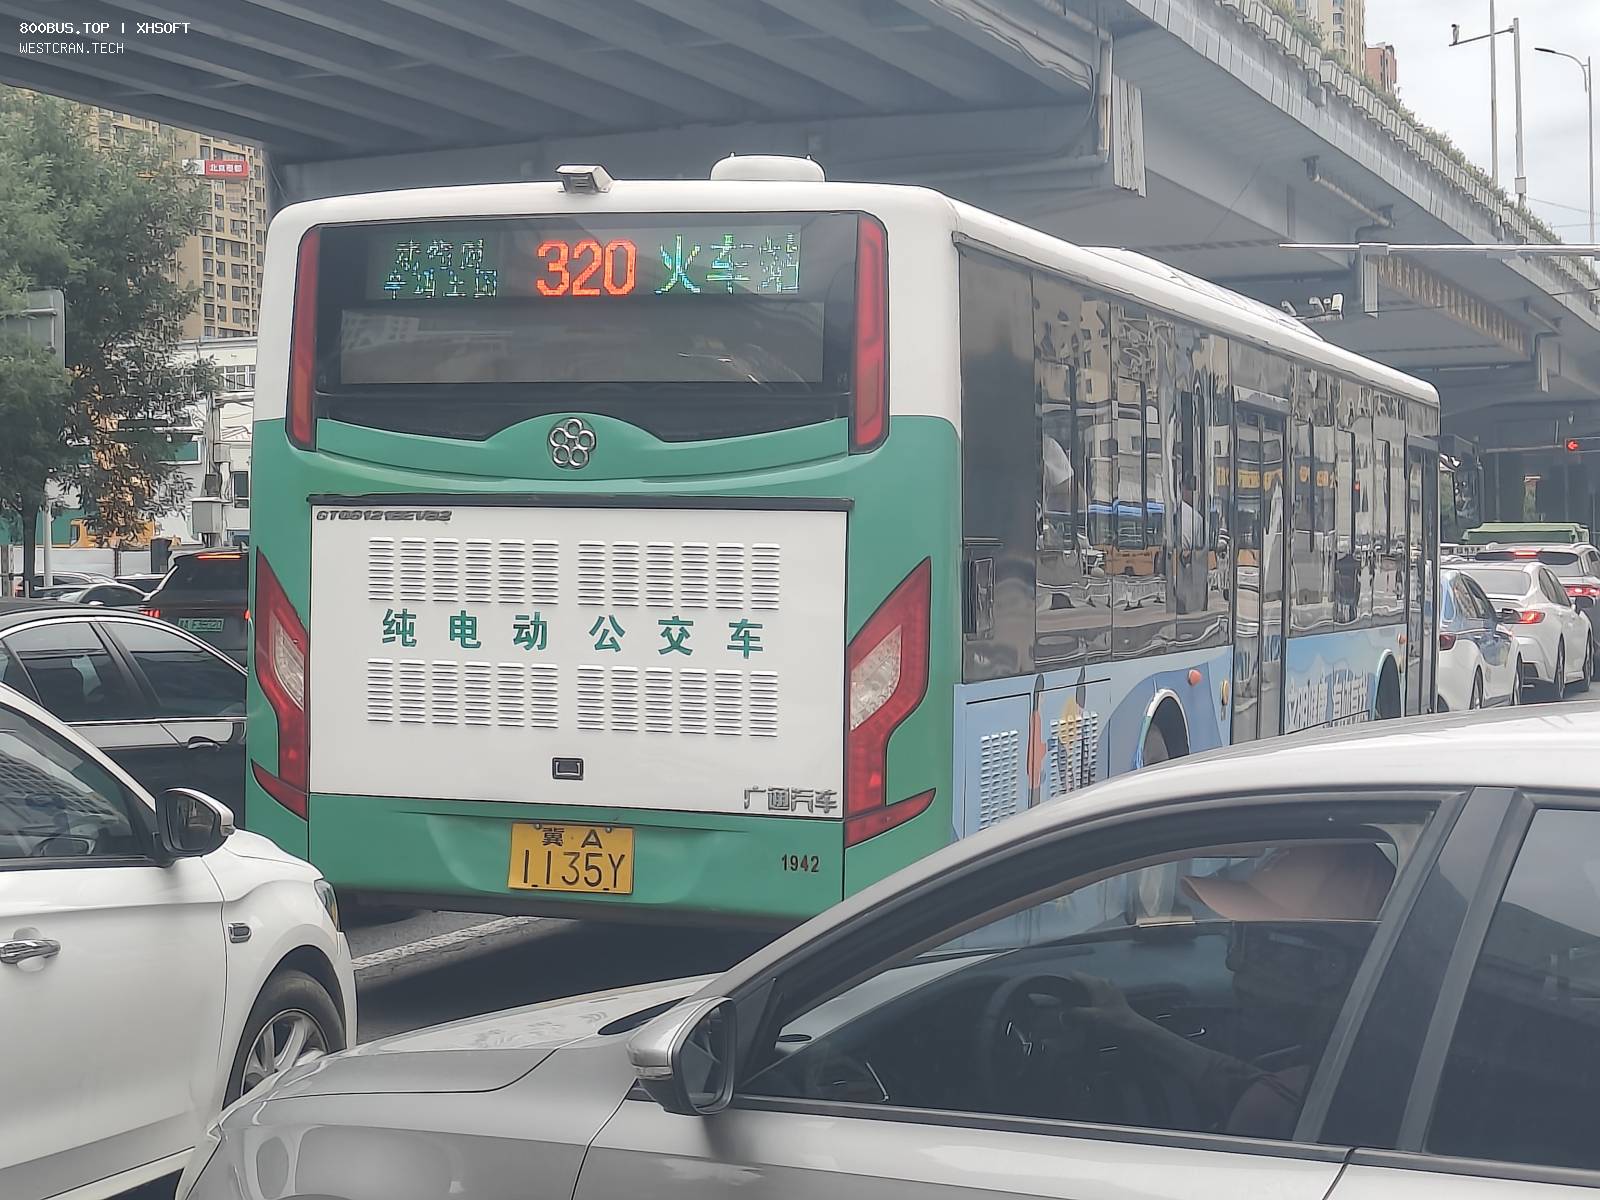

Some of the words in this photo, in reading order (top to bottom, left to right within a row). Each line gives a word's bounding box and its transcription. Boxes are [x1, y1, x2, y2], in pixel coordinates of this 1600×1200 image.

[536, 240, 637, 297] 320
[382, 608, 764, 660] 纯电动公交车
[743, 786, 837, 814] 广通汽车
[522, 849, 625, 889] 1135Y
[781, 853, 820, 873] 1942
